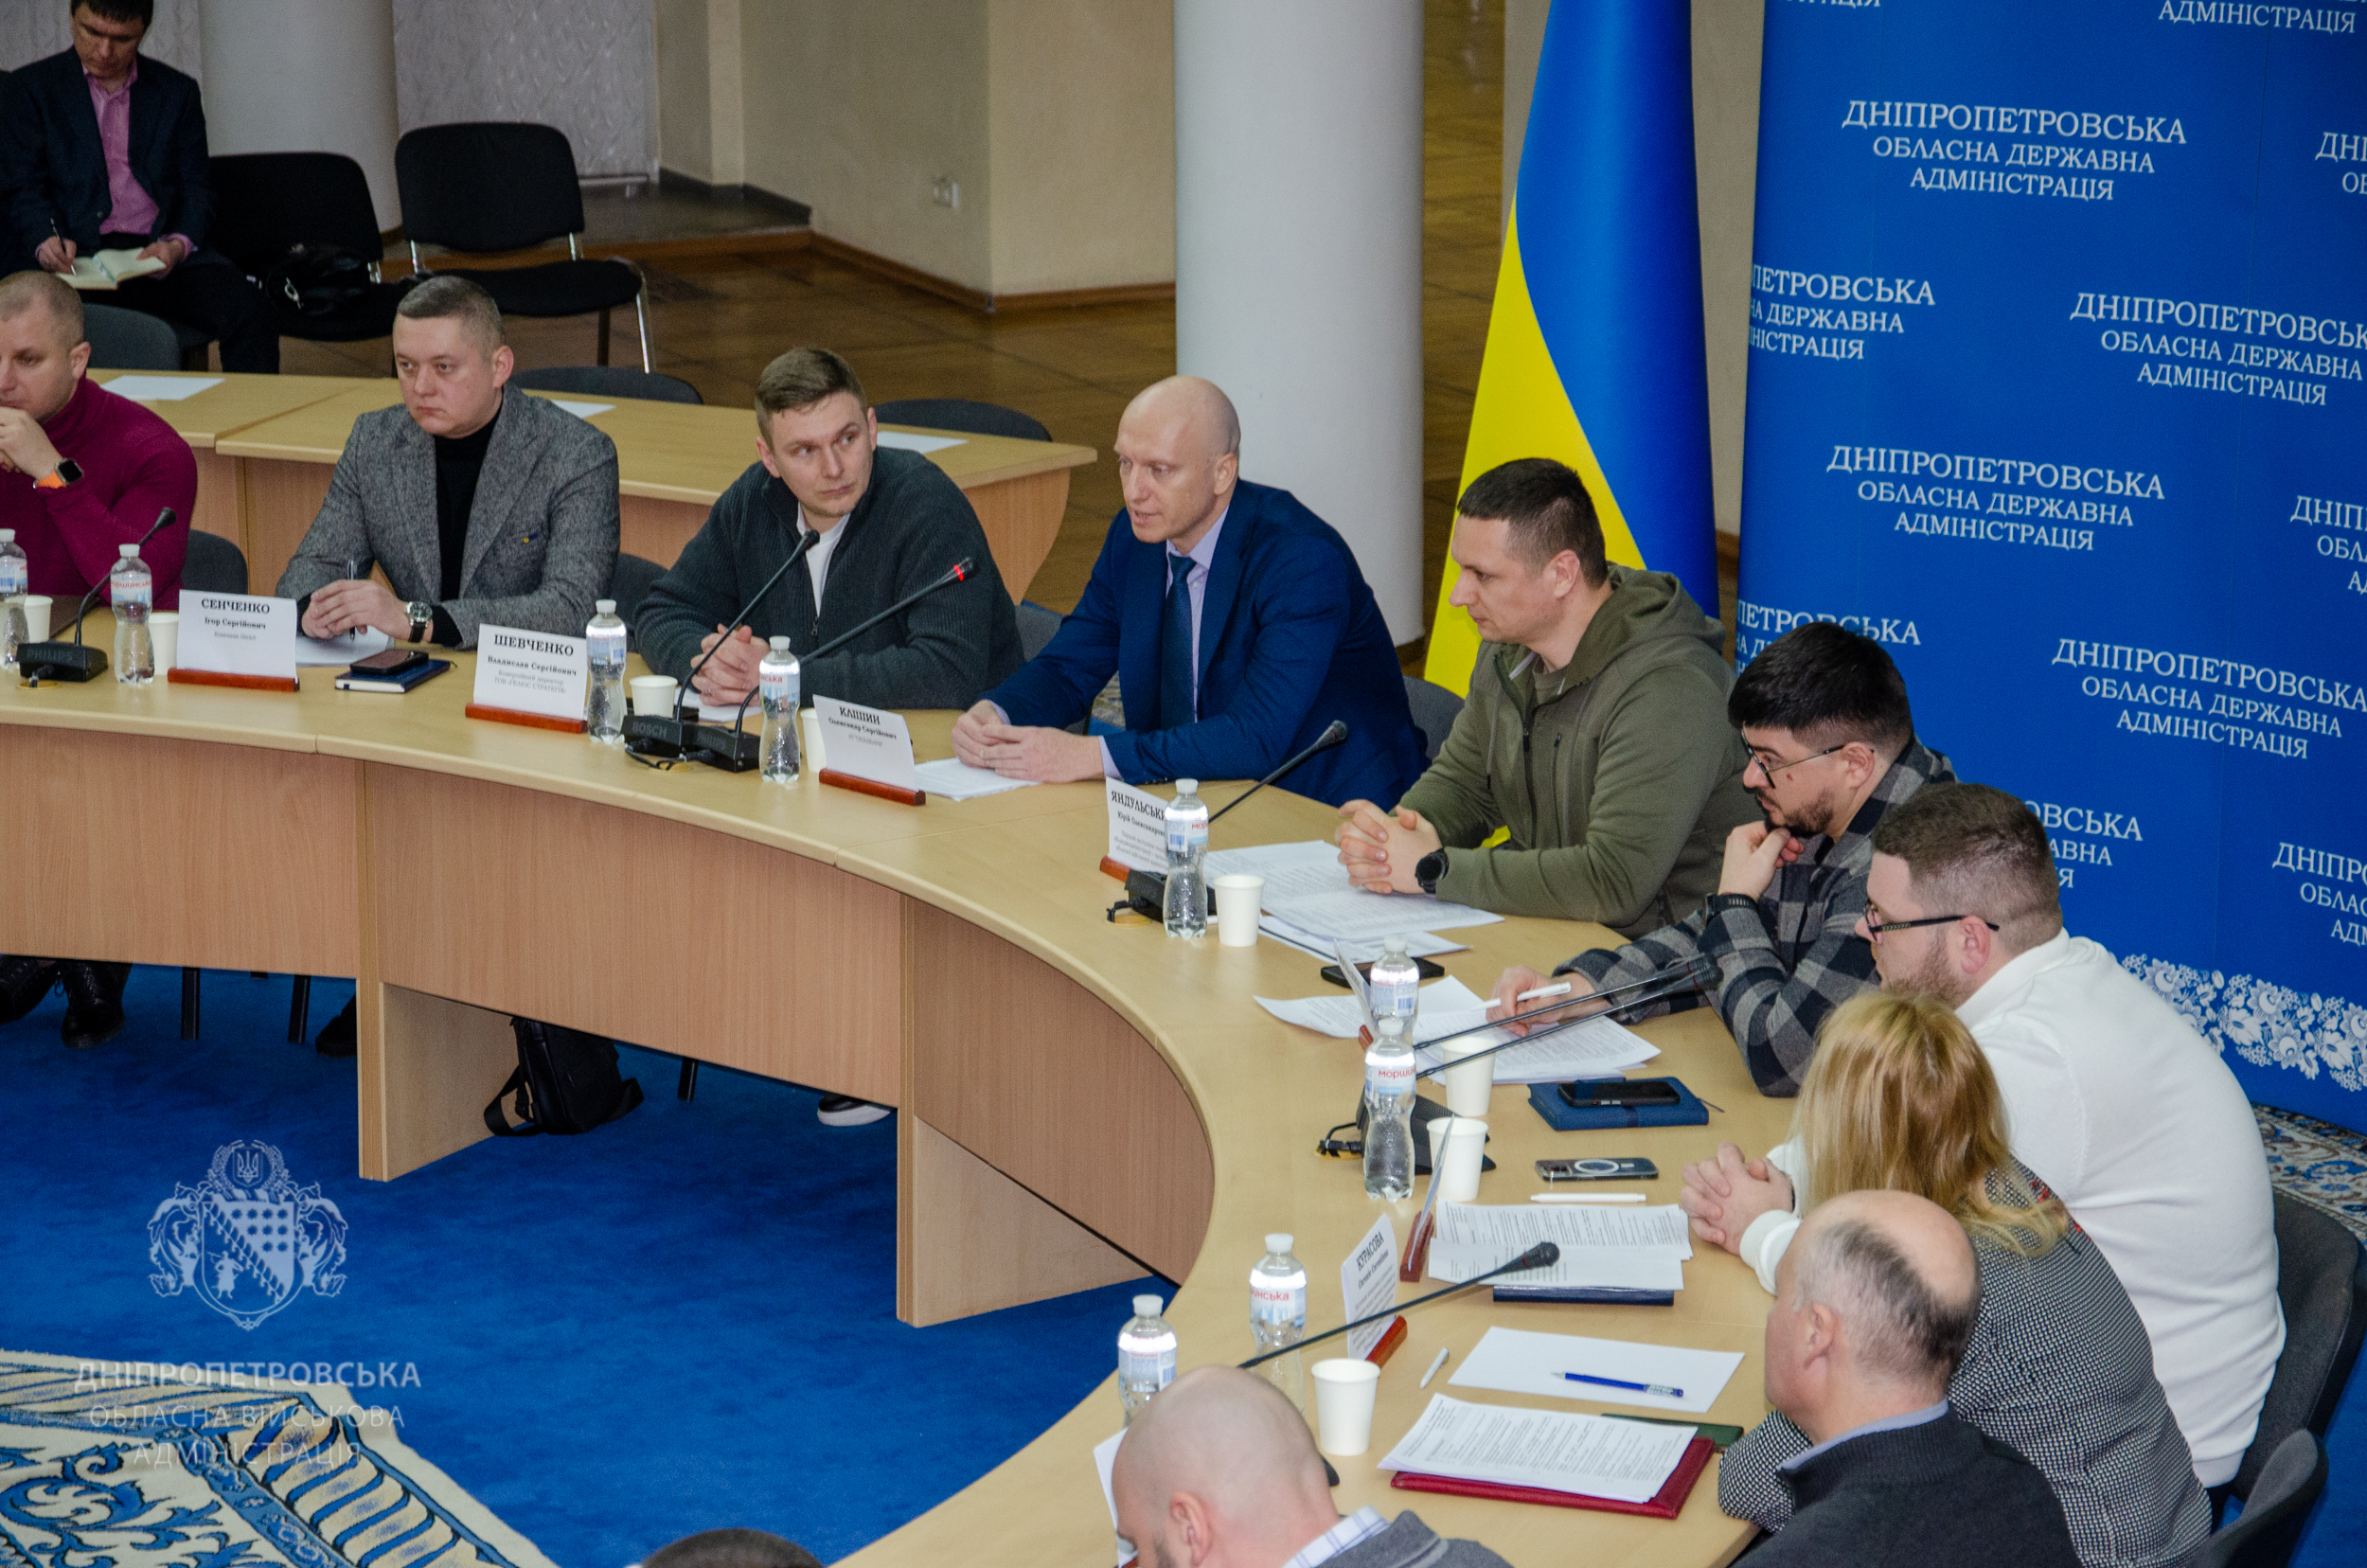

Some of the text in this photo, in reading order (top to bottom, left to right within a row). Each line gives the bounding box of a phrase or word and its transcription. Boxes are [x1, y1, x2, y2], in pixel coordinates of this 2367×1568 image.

[2159, 0, 2356, 33] АДМІНІСТРАЦІЯ
[1841, 100, 2187, 145] ДНІПРОПЕТРОВСЬКА
[1873, 135, 2155, 174] ОБЛАСНА ДЕРЖАВНА
[1910, 167, 2114, 202] АДМІНІСТРАЦІЯ
[1766, 302, 1904, 333] ДЕРЖАВНА
[2101, 330, 2362, 381] ОБЛАСНА ДЕРЖАВНА
[2137, 362, 2326, 406] АДМІНІСТРАЦІЯ
[1826, 445, 2165, 500] ДНІПРОПЕТРОВСЬКА
[1858, 480, 2134, 527] ОБЛАСНА ДЕРЖАВНА
[1894, 511, 2094, 551] АДМІНІСТРАЦІЯ
[201, 597, 271, 615] СЕНЧЕНКО
[494, 634, 574, 656] ШЕВЧЕНКО
[488, 655, 577, 676] Владислав Сергійович
[2052, 638, 2367, 713] ДНІПРОПЕТРОВСЬКА
[2082, 676, 2342, 738] ОБЛАСНА ДЕРЖАВНА
[632, 722, 667, 738] BOSCH
[2116, 709, 2308, 759] АДМІНІСТРАЦІЯ
